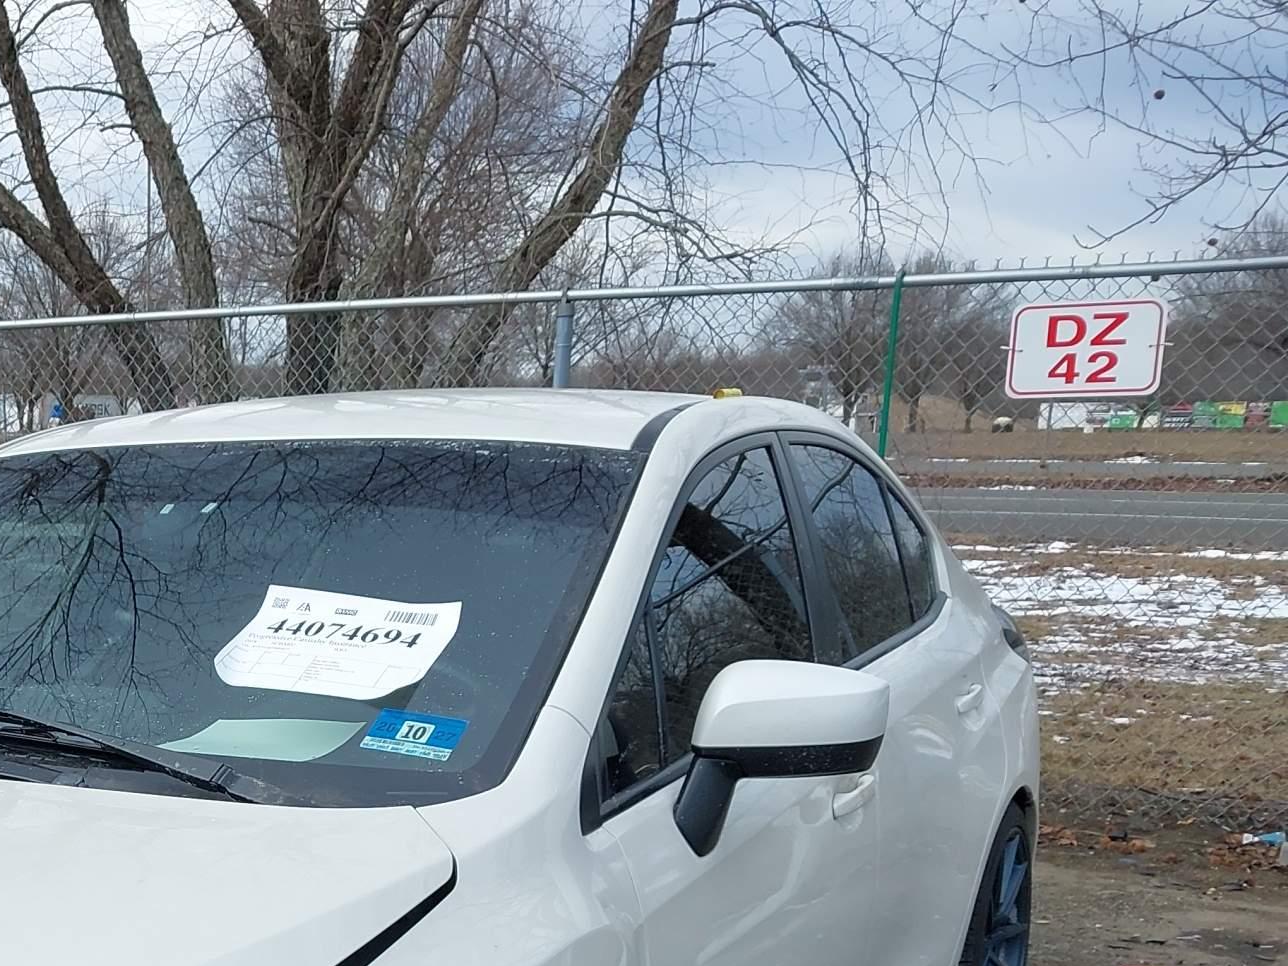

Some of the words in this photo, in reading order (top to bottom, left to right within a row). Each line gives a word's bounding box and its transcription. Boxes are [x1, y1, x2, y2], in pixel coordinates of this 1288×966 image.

[1046, 312, 1130, 348] DZ
[1047, 351, 1119, 384] 42
[266, 618, 422, 649] 44074694
[401, 724, 427, 741] 10
